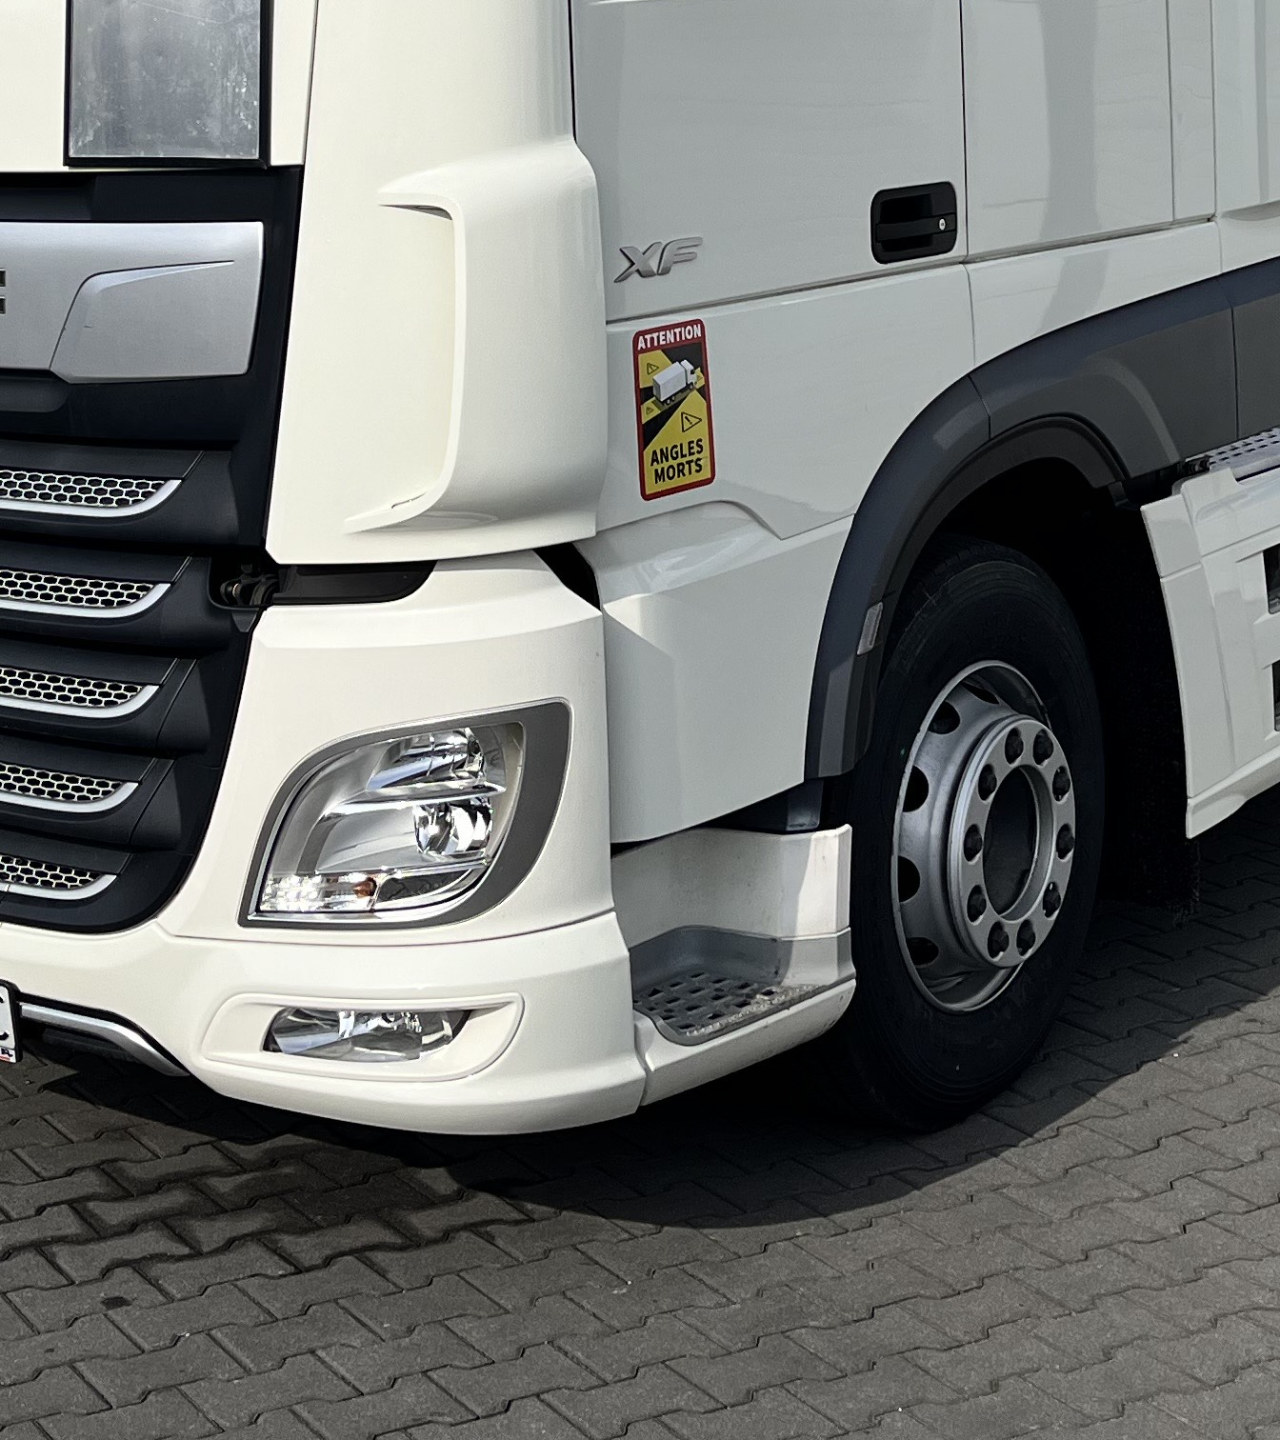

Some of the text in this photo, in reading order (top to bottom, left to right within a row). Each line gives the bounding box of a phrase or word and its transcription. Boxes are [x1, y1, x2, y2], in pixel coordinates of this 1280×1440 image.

[613, 236, 703, 284] XF
[637, 323, 702, 351] ATTENTION
[650, 438, 704, 466] ANGLES
[654, 457, 703, 485] MORTS
